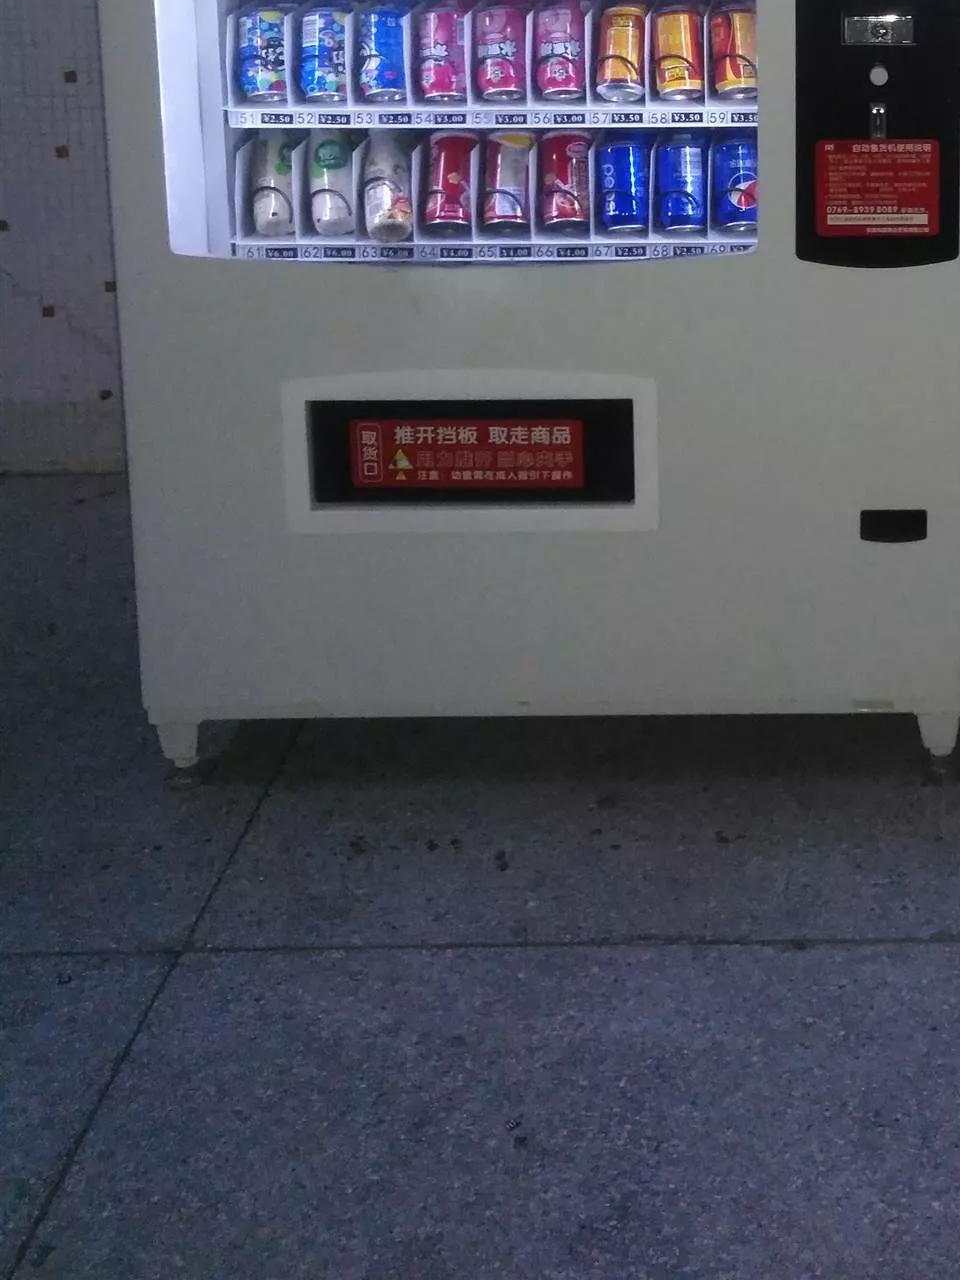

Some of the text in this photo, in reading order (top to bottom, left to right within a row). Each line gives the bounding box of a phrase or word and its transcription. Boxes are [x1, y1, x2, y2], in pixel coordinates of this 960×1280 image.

[263, 114, 291, 123] ¥2.50
[297, 114, 348, 124] 52 ¥2.50
[357, 114, 409, 124] 53 ¥2.50
[415, 114, 431, 124] 54
[534, 113, 583, 123] 56 ¥3.00
[592, 113, 640, 123] 57 ¥3.50
[651, 113, 700, 123] 58 ¥3.50
[710, 113, 725, 123] 59
[304, 248, 320, 257] 62
[362, 248, 378, 257] 63
[479, 248, 494, 257] 65
[536, 248, 552, 257] 66
[595, 247, 645, 257] 67 ¥2.50
[653, 247, 668, 257] 68
[395, 426, 571, 445] 推开挡板 取走商品
[361, 430, 379, 476] 取货口
